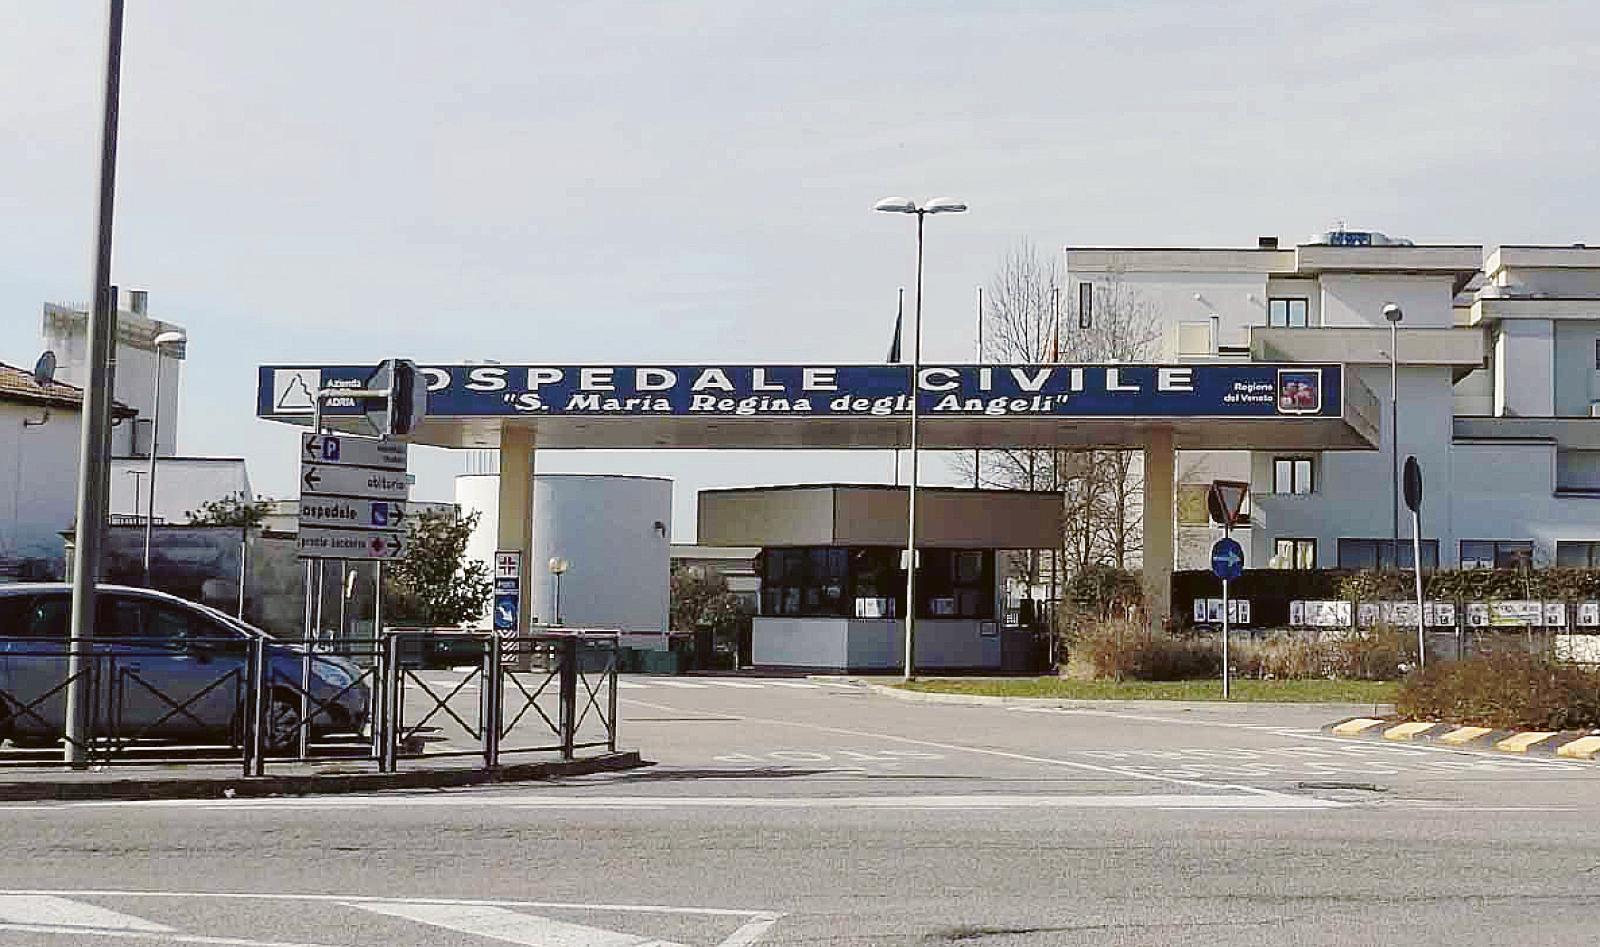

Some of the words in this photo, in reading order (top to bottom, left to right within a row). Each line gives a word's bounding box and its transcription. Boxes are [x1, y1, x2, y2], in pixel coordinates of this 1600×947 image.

[423, 368, 838, 391] OSPEDALE
[917, 367, 1194, 391] CIVILE
[1234, 382, 1273, 394] Regione
[325, 397, 356, 407] ADRIA
[565, 394, 671, 411] Maria
[688, 394, 812, 415] Regina
[830, 394, 914, 415] degli
[933, 394, 1068, 415] Angeli"
[1223, 393, 1240, 402] del
[1240, 394, 1273, 402] Veneto
[303, 503, 358, 519] ospedale
